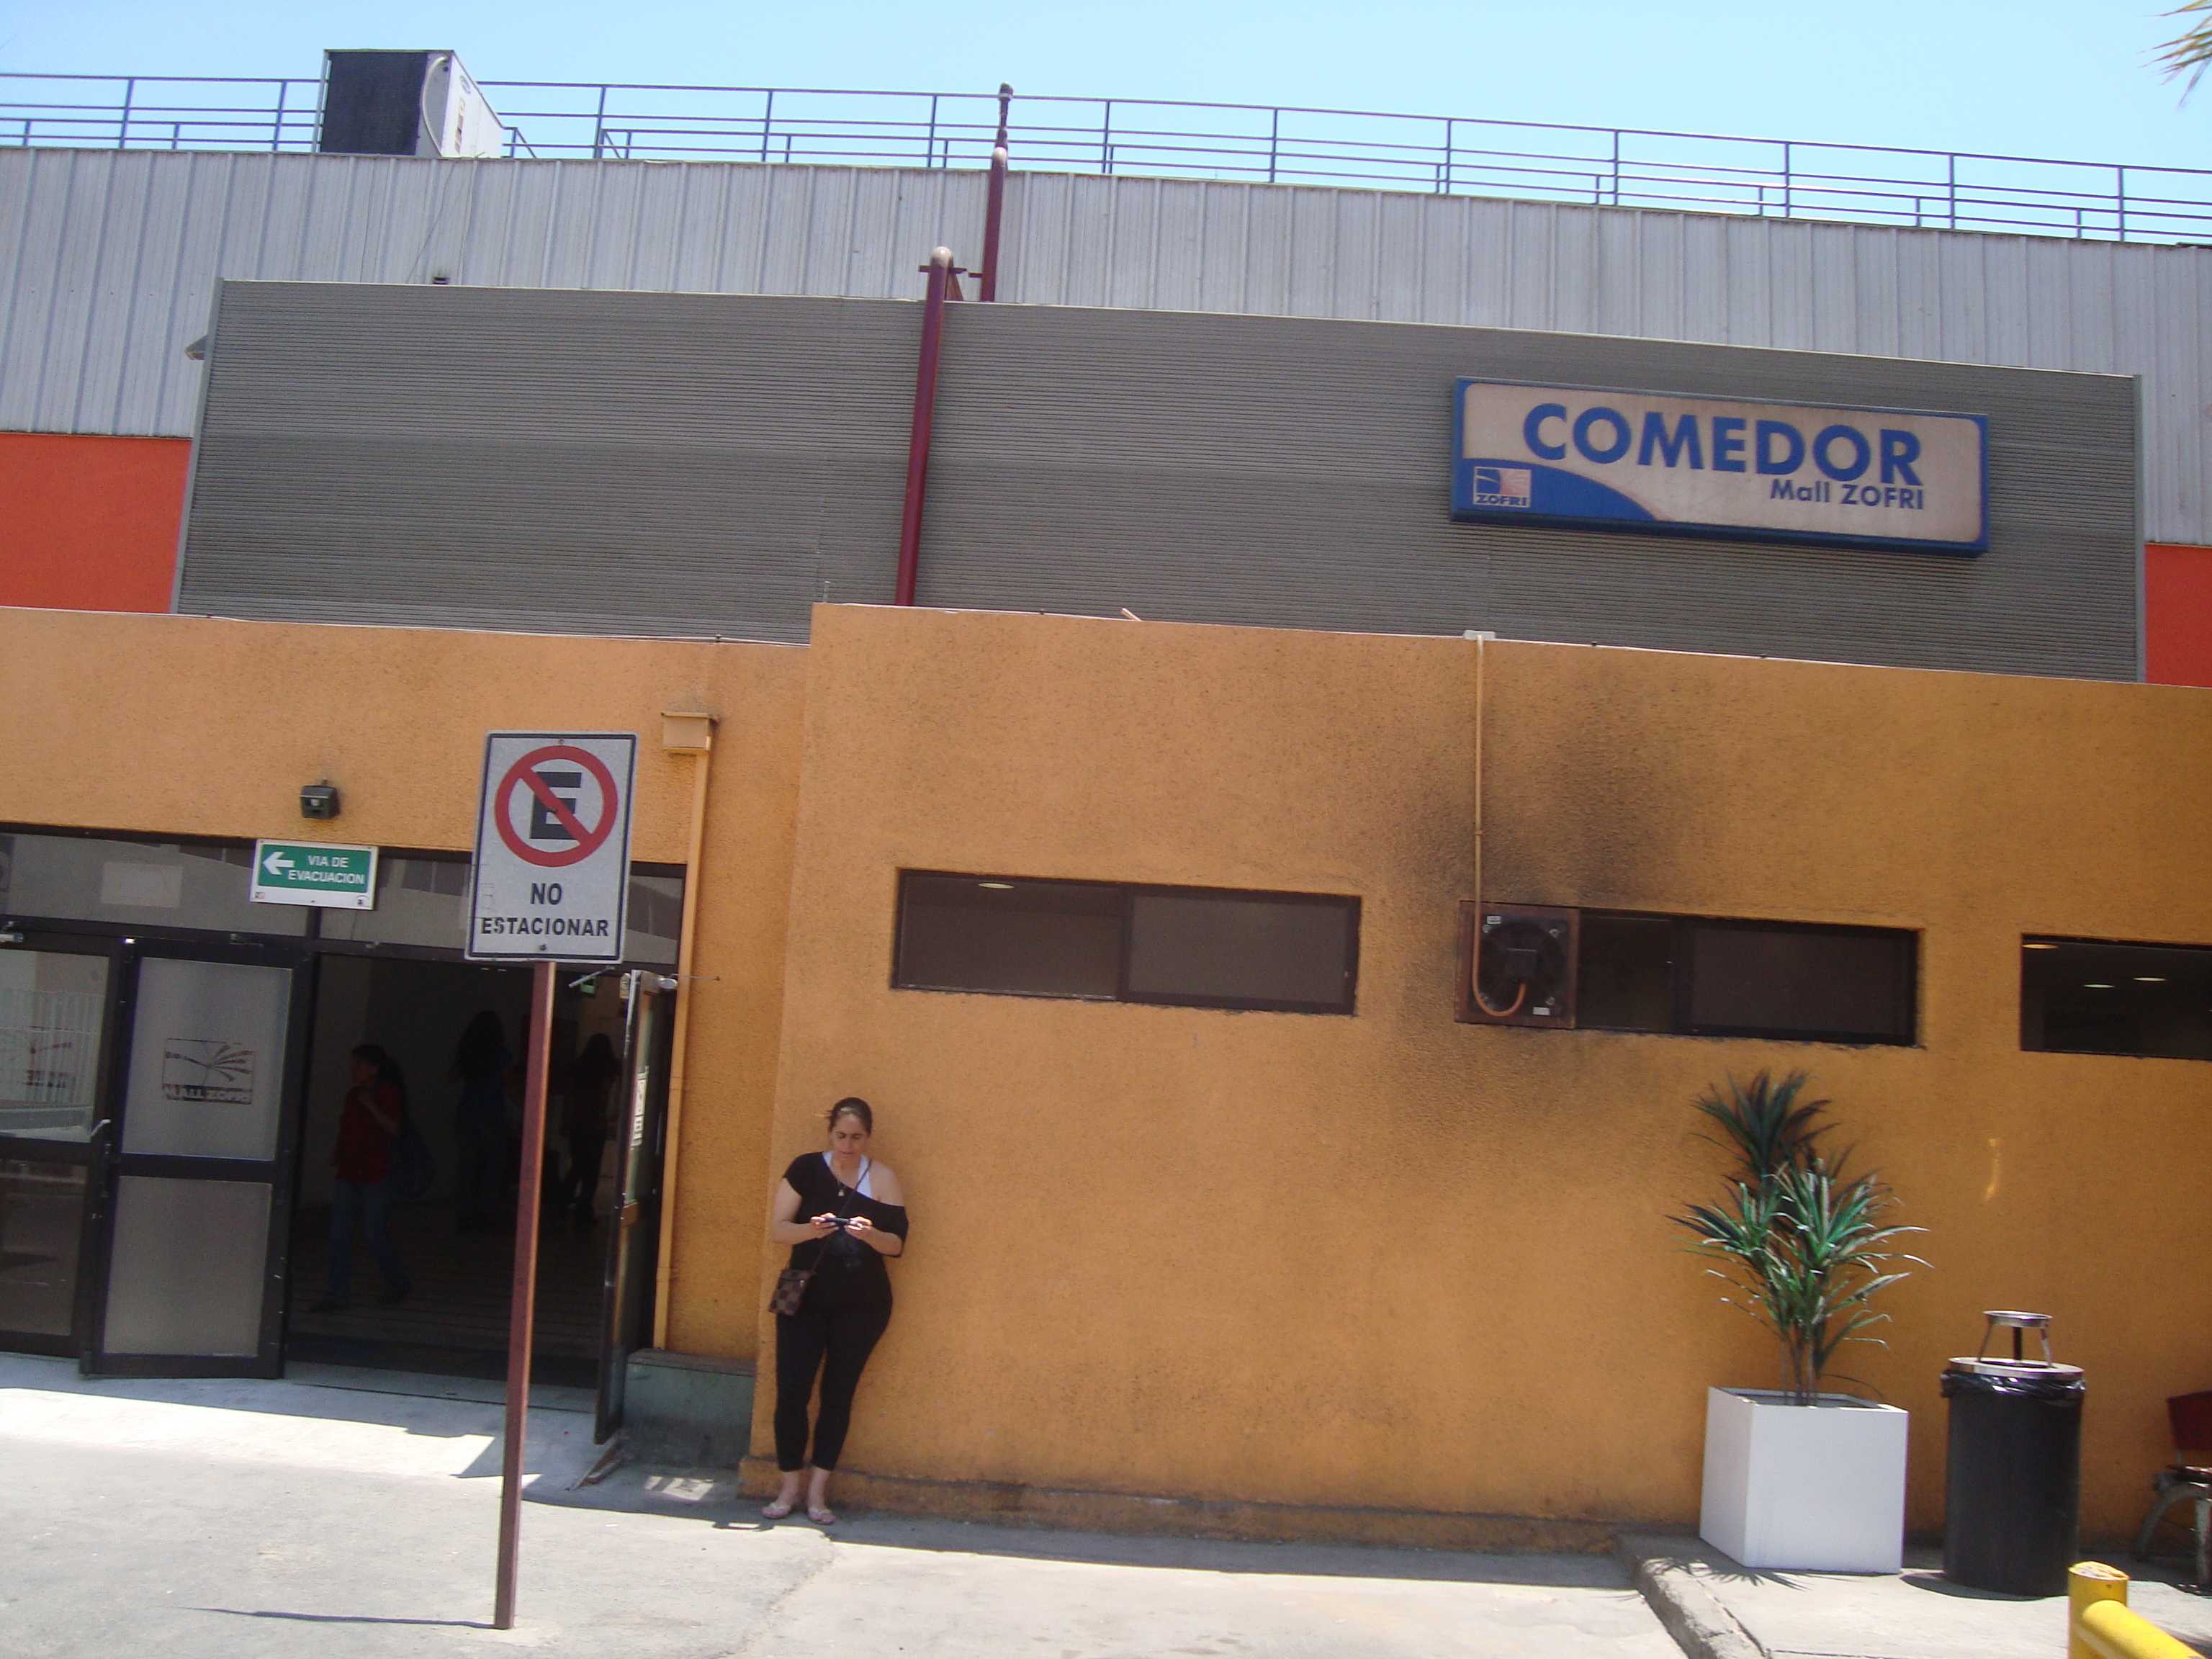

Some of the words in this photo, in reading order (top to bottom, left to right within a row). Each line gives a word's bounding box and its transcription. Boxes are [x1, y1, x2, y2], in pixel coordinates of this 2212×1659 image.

[1523, 403, 1924, 485] COMEDOR
[1475, 494, 1527, 506] ZOFRI
[1770, 479, 1830, 503] Mall
[1841, 484, 1924, 510] ZOFRI
[307, 855, 330, 866] VIA
[331, 857, 349, 868] DE
[288, 869, 365, 884] EVACUACION
[530, 883, 563, 905] NO
[480, 917, 609, 936] ESTACIONAR
